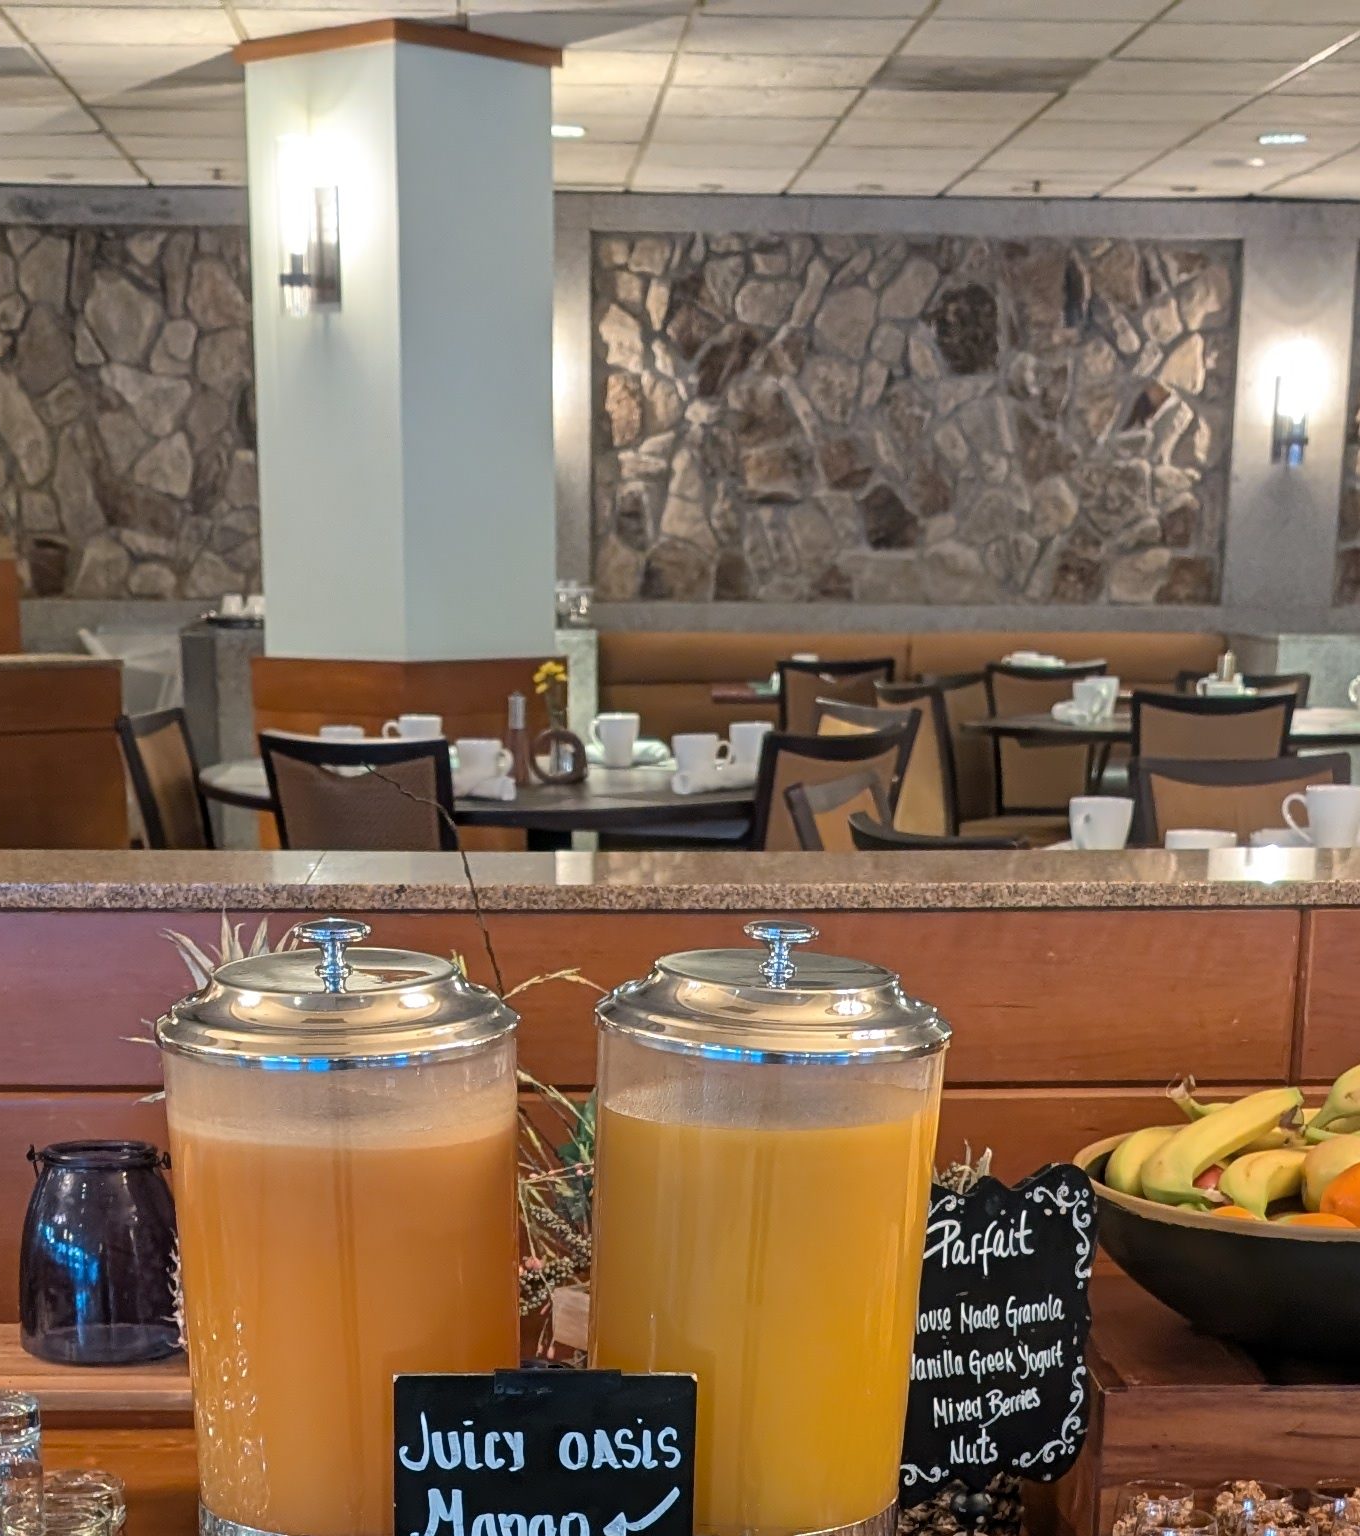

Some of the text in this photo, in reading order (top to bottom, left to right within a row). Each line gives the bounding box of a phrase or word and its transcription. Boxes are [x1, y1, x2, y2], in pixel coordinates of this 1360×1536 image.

[922, 1209, 1035, 1276] Parfait
[960, 1302, 1000, 1334] Made
[1006, 1293, 1066, 1337] Granola
[969, 1347, 1017, 1384] Greek
[1017, 1339, 1065, 1380] Yogurt
[933, 1386, 1041, 1429] Mixed Berries
[949, 1427, 999, 1465] Nuts
